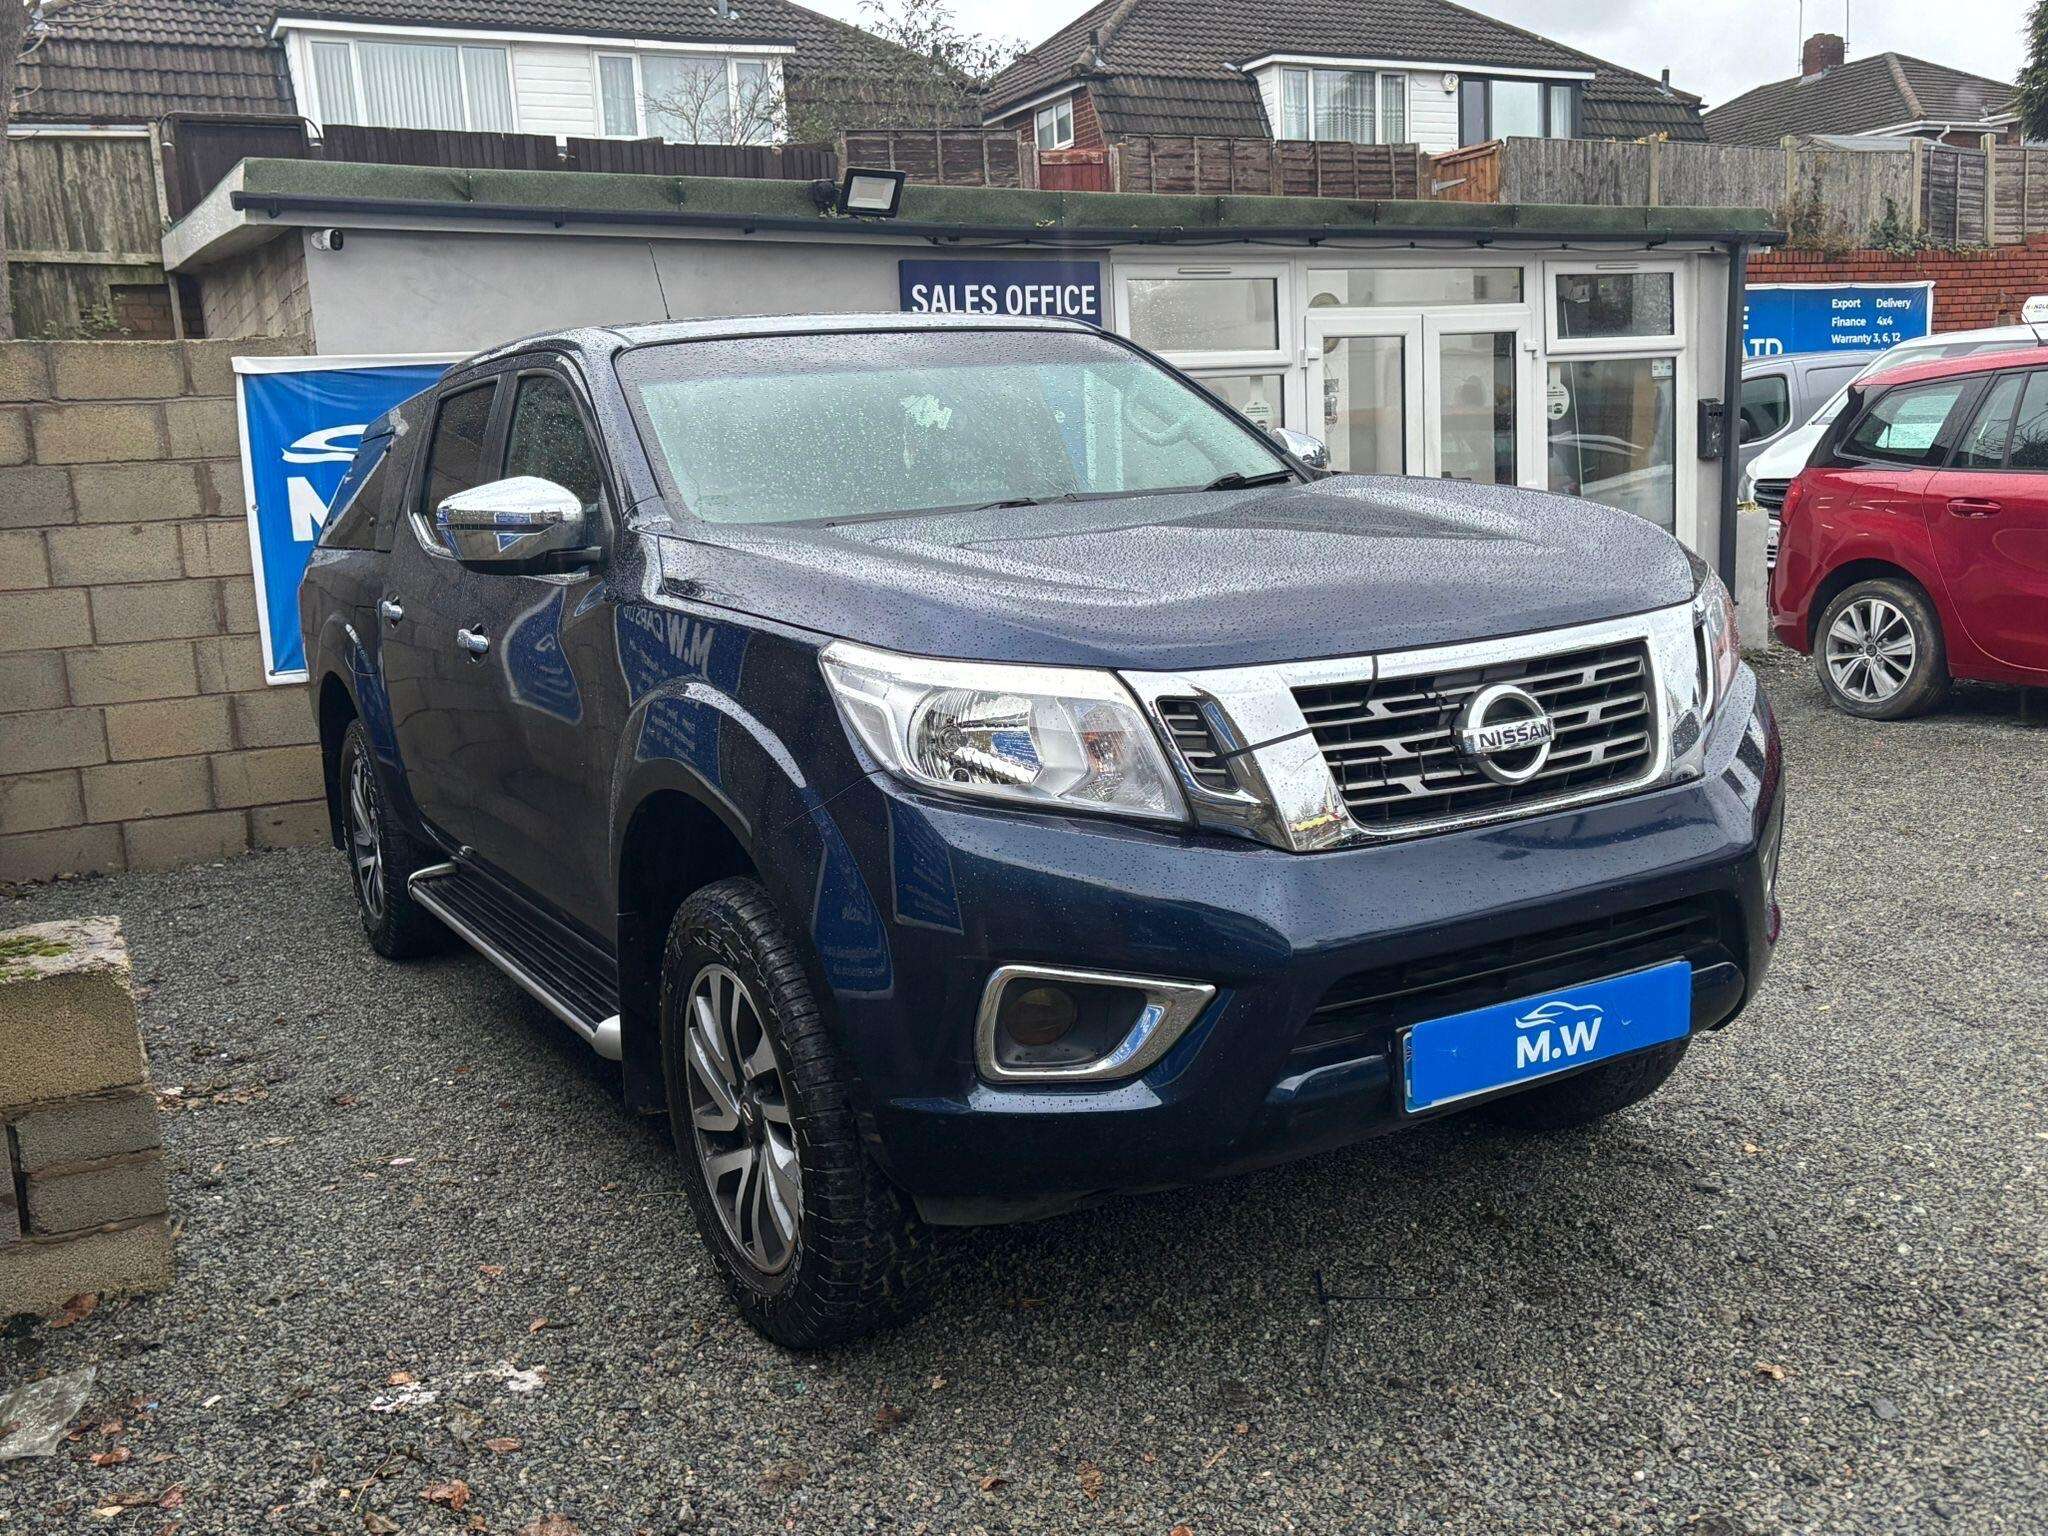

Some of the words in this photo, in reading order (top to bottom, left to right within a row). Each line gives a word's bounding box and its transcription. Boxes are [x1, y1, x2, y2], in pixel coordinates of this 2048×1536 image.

[911, 284, 998, 315] SALES
[1005, 285, 1096, 315] OFFICE
[1831, 298, 1861, 310] Export
[1876, 297, 1912, 310] Delivery
[1831, 316, 1867, 327] Finance
[1876, 316, 1893, 326] 4x4
[1831, 333, 1871, 345] Warranty
[1891, 332, 1901, 342] 12
[1478, 718, 1552, 748] NISSAN
[1516, 1016, 1603, 1069] M.W
